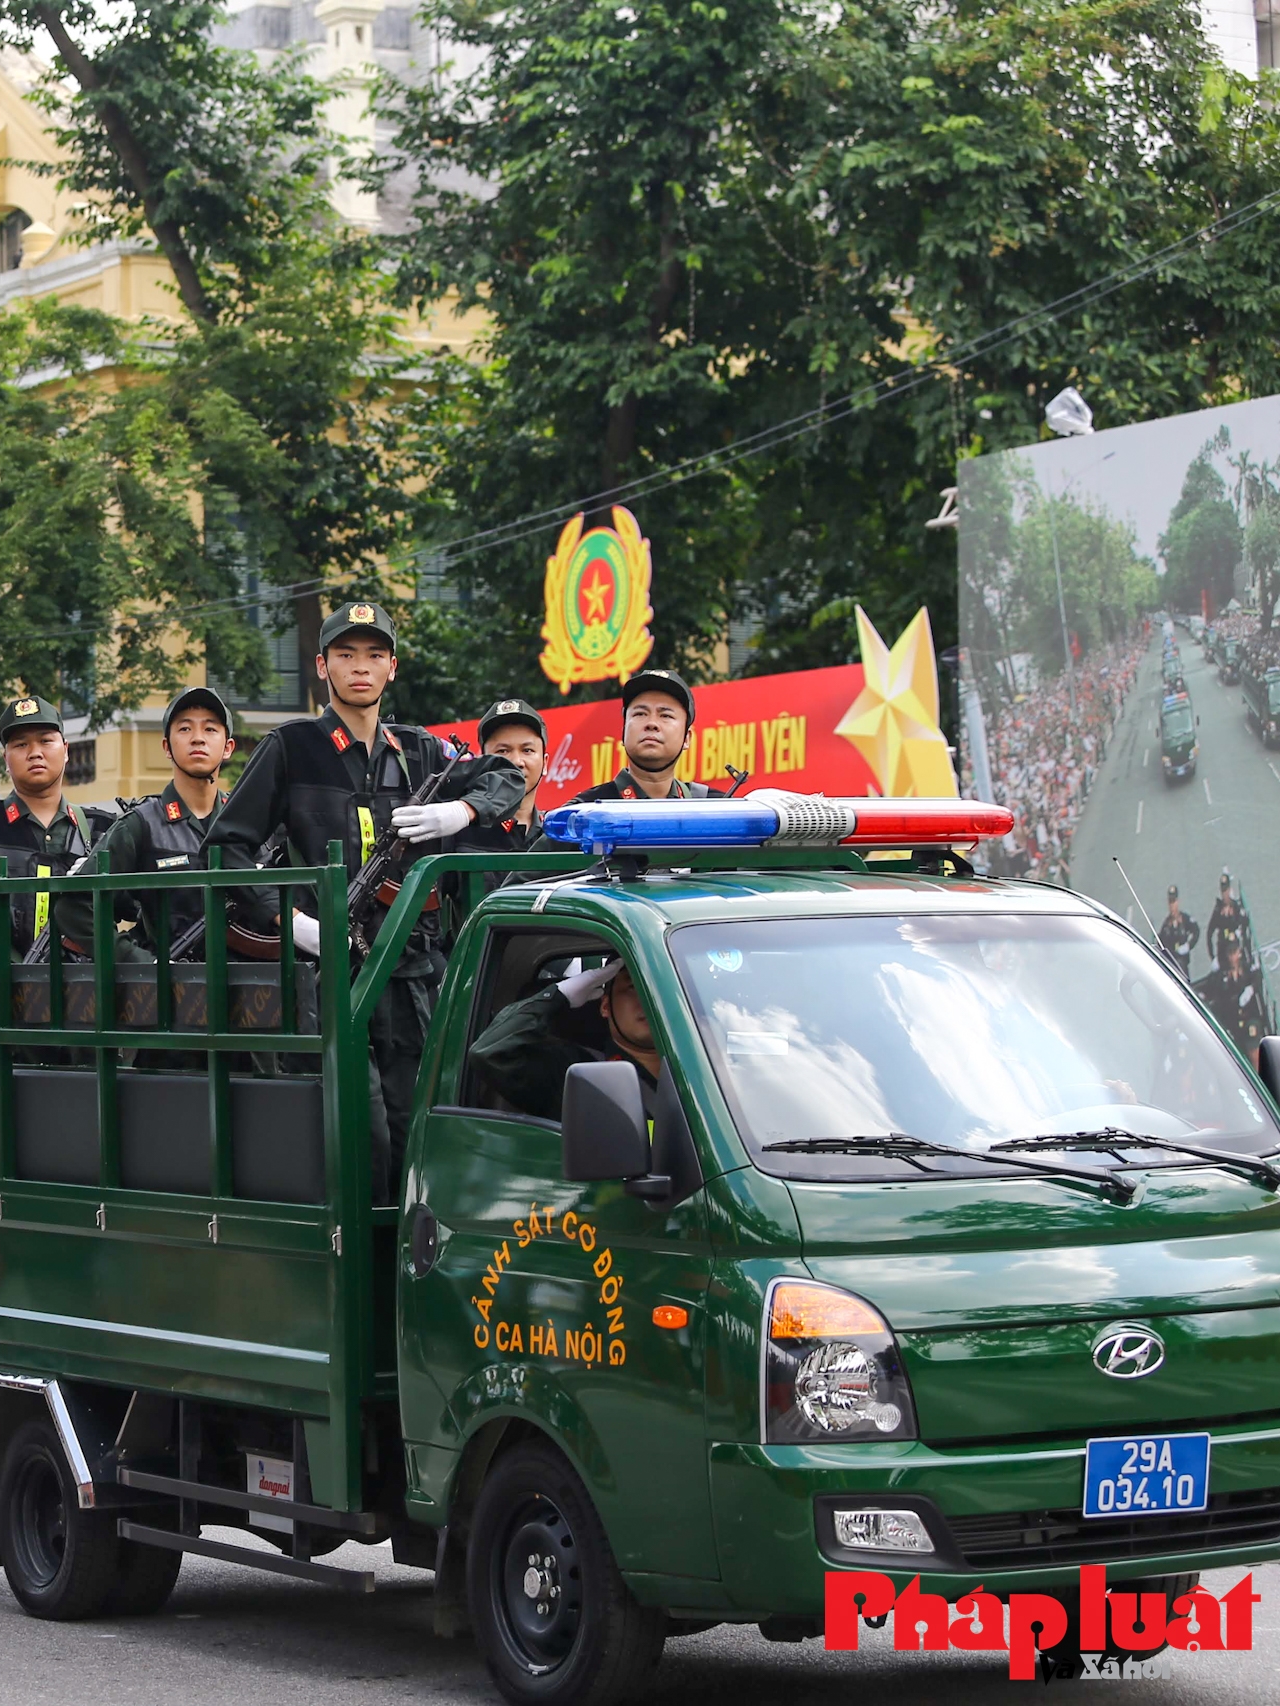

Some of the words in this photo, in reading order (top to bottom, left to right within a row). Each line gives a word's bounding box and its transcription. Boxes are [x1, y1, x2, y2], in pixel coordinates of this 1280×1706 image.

[591, 736, 615, 786] VÌ
[701, 719, 757, 781] BÌNH
[761, 711, 807, 774] YÊN
[471, 1240, 512, 1349] CẢNH
[513, 1202, 556, 1248] SÁT
[562, 1211, 597, 1252] CƠ
[592, 1248, 626, 1366] ĐỘNG
[496, 1321, 524, 1353] CA
[529, 1318, 559, 1357] HÀ
[565, 1322, 603, 1370] NỘI
[1121, 1440, 1173, 1474] 29A
[1098, 1474, 1194, 1511] 034.10
